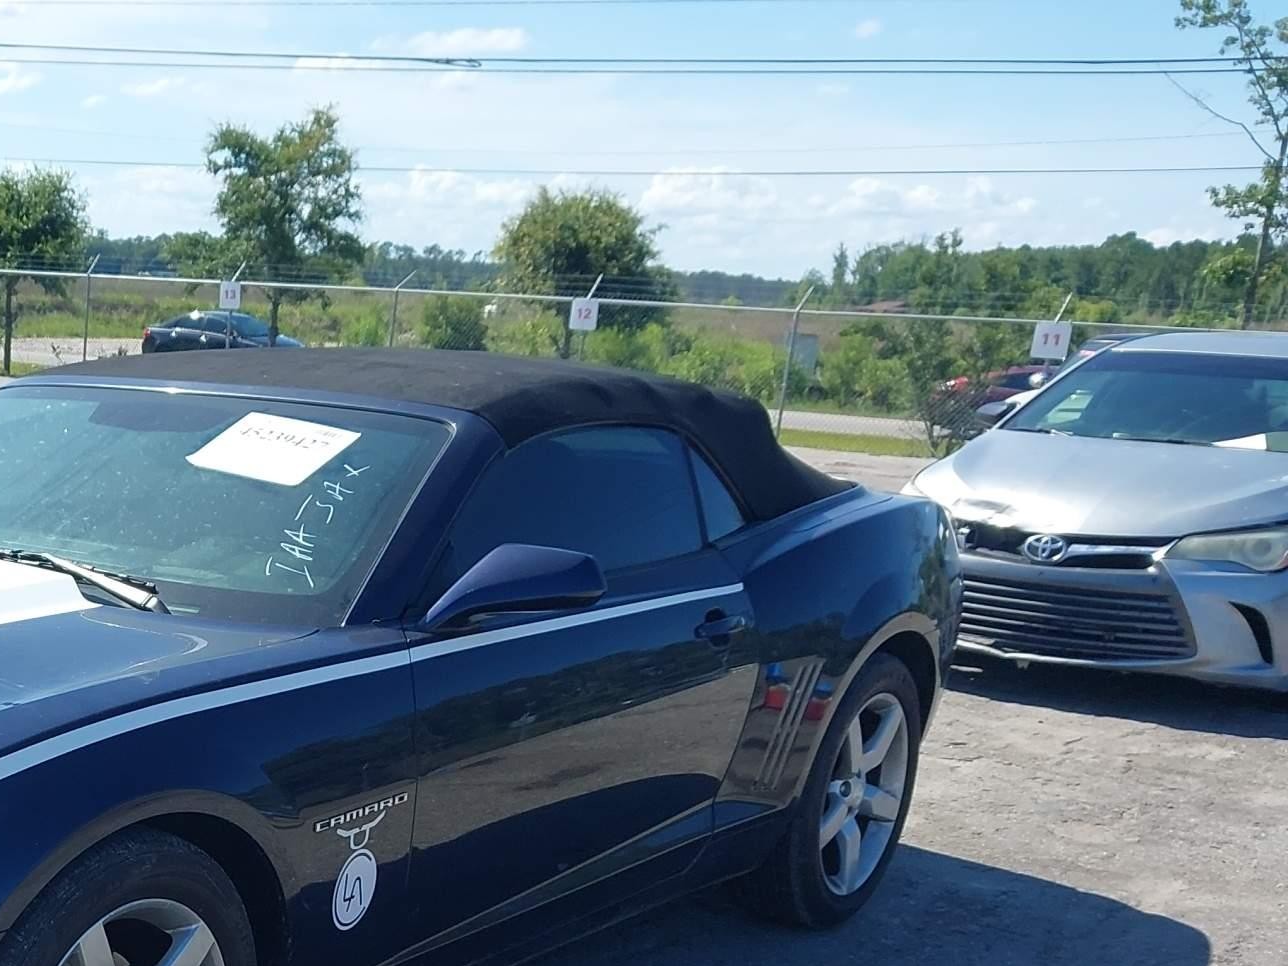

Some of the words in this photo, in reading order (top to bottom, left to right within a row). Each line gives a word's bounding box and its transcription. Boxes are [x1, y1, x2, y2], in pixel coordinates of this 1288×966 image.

[577, 308, 592, 321] 12
[1041, 333, 1061, 347] 11
[314, 792, 409, 833] CAMARO
